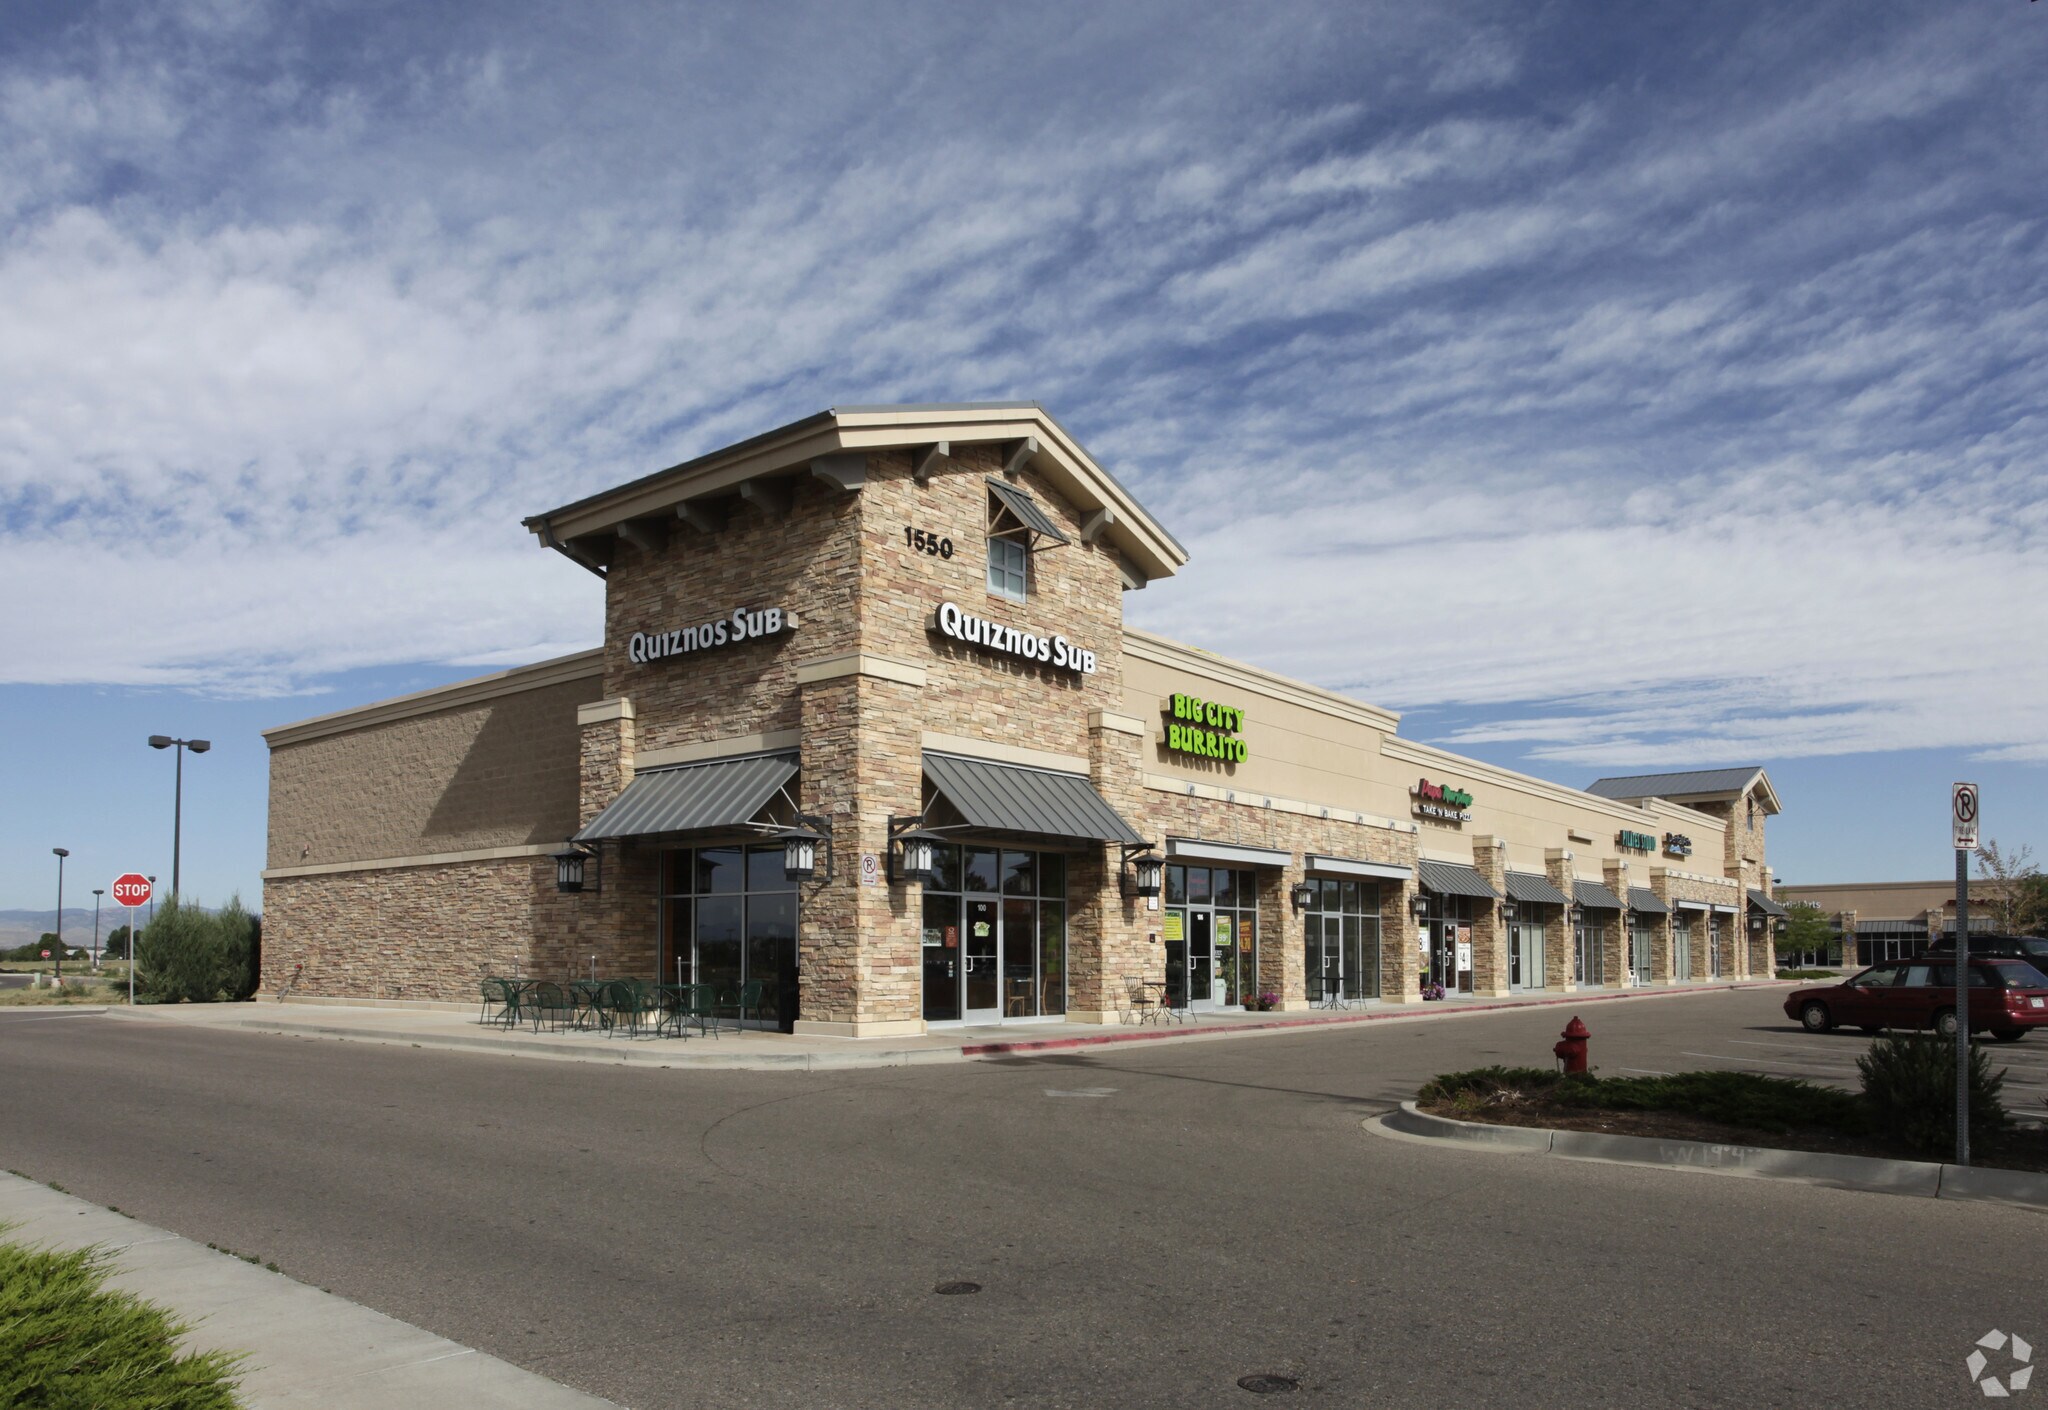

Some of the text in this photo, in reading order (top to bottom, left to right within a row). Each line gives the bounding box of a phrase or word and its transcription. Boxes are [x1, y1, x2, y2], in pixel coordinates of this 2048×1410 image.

[904, 526, 953, 559] 1550
[1174, 693, 1245, 733] BIG CITY
[1169, 724, 1248, 763] BURRITO
[1423, 804, 1437, 815] TAKE
[1445, 809, 1458, 819] BAKE
[115, 884, 150, 896] STOP
